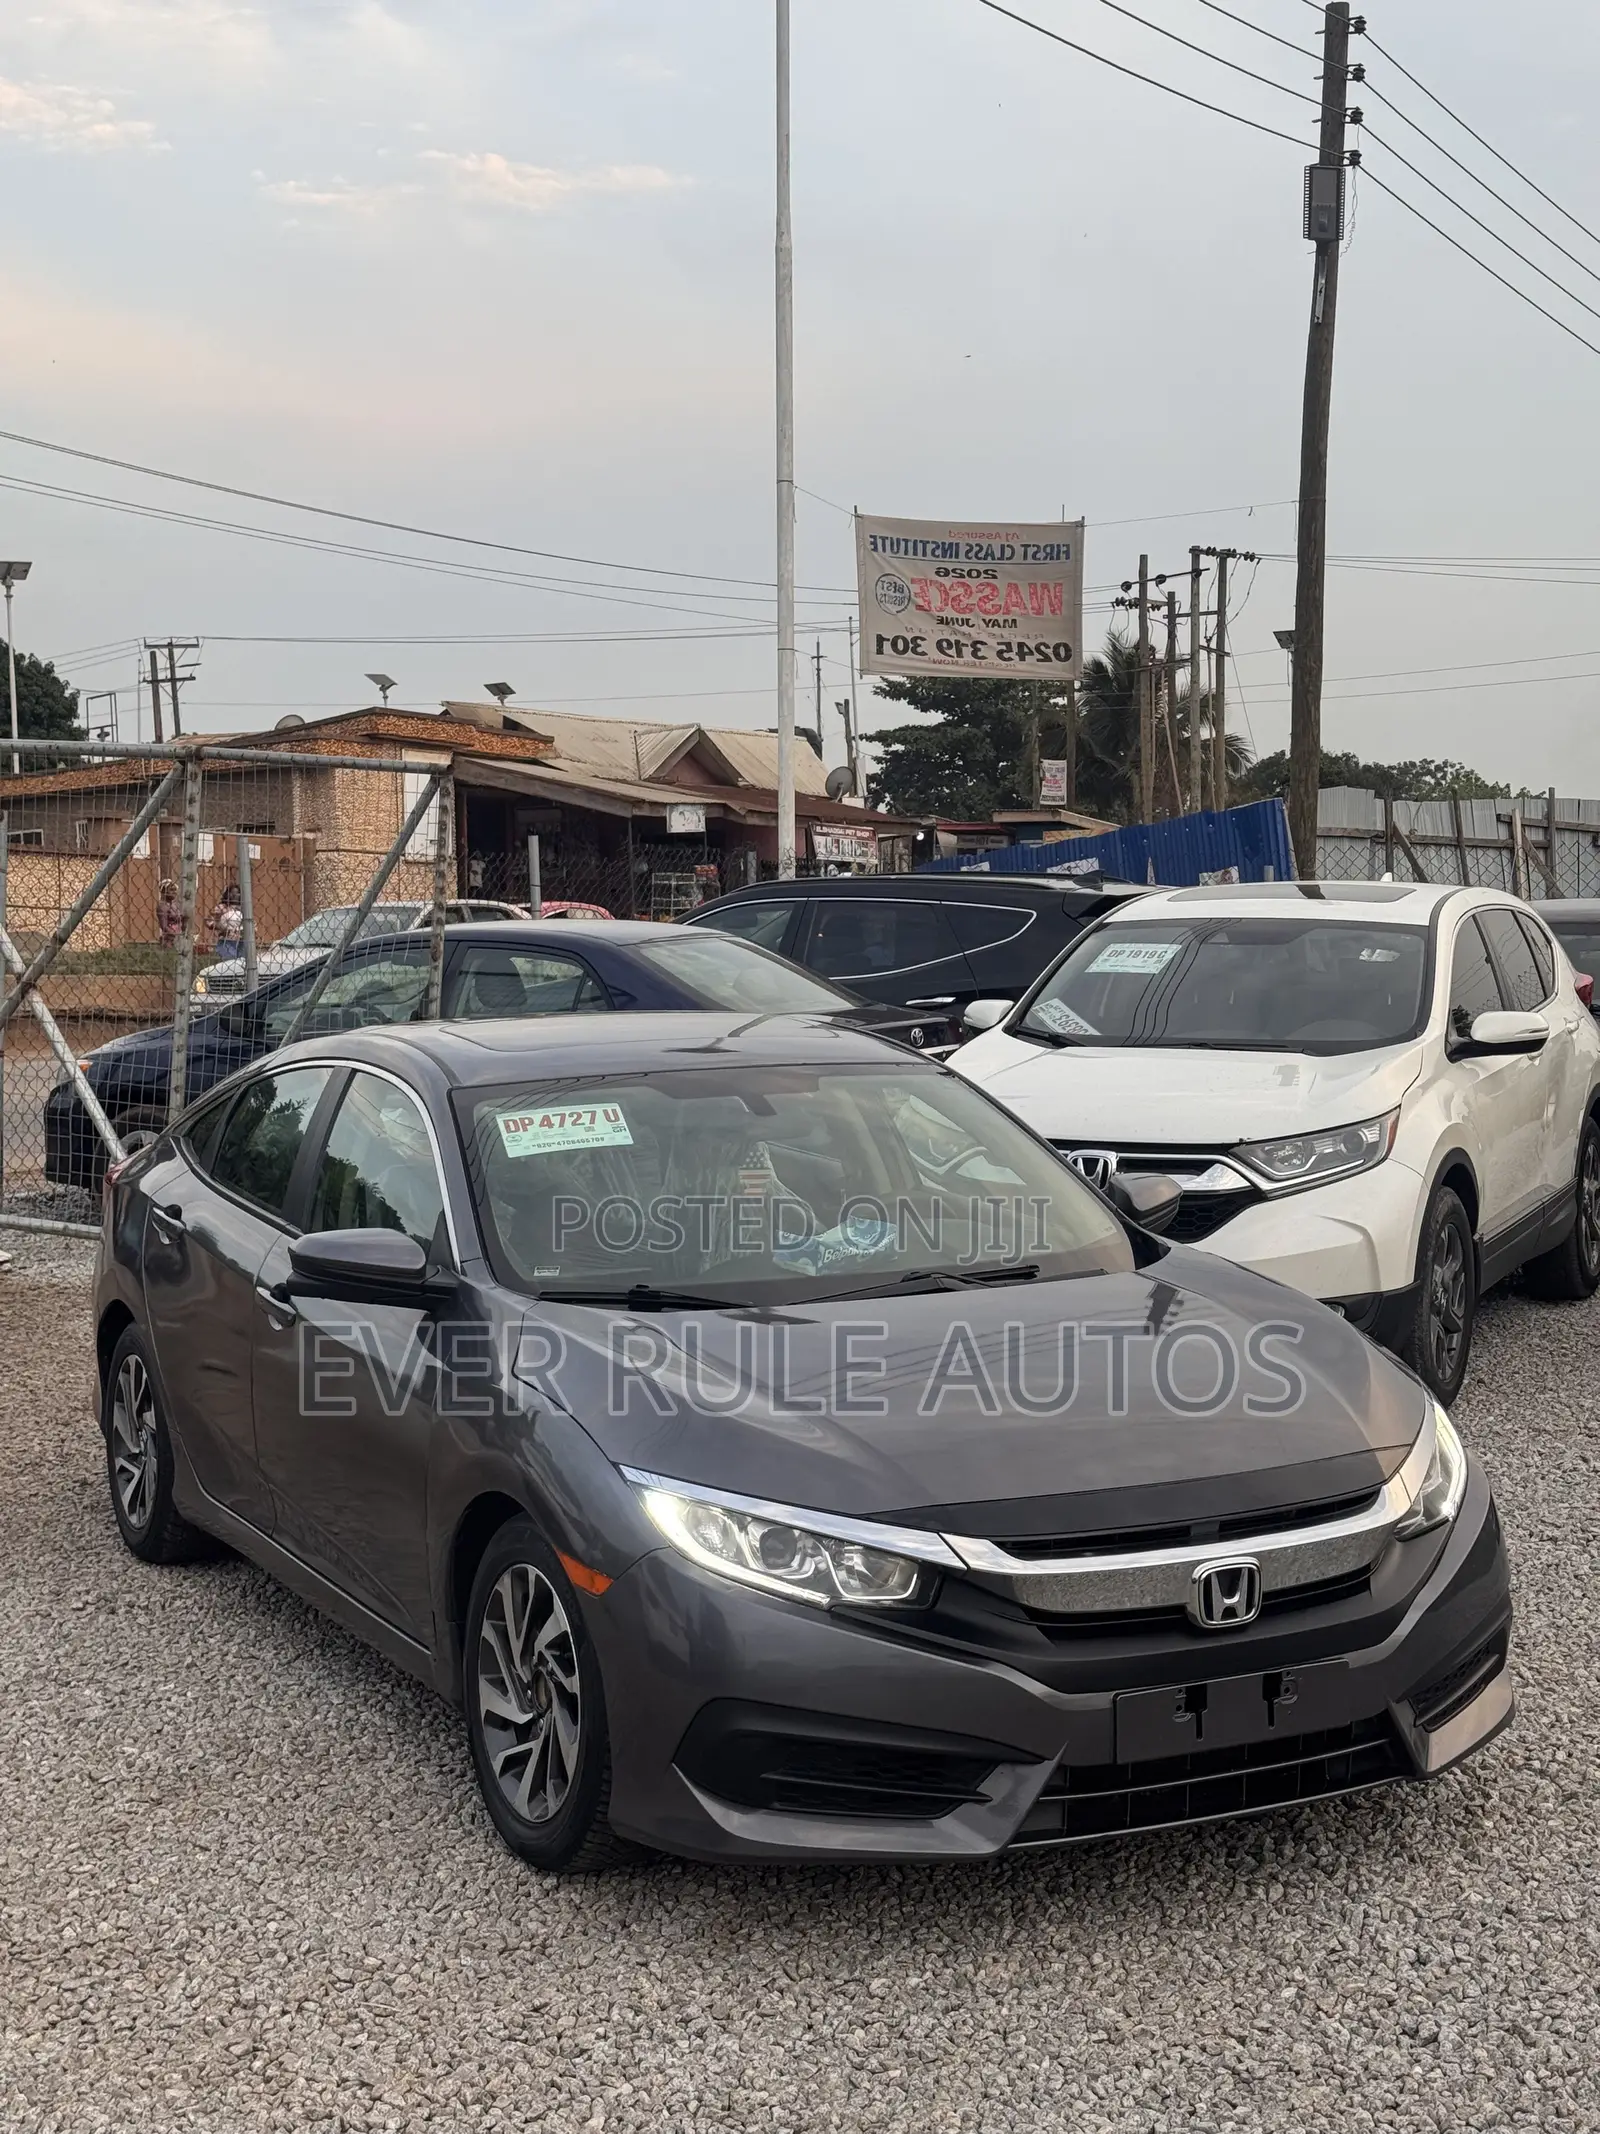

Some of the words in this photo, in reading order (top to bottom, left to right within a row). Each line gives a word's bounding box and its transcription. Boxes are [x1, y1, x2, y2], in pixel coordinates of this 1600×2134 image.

[1107, 949, 1126, 959] DP
[1127, 949, 1157, 959] 1919
[503, 1116, 535, 1134] DP
[539, 1110, 597, 1130] 4727
[603, 1108, 621, 1123] U
